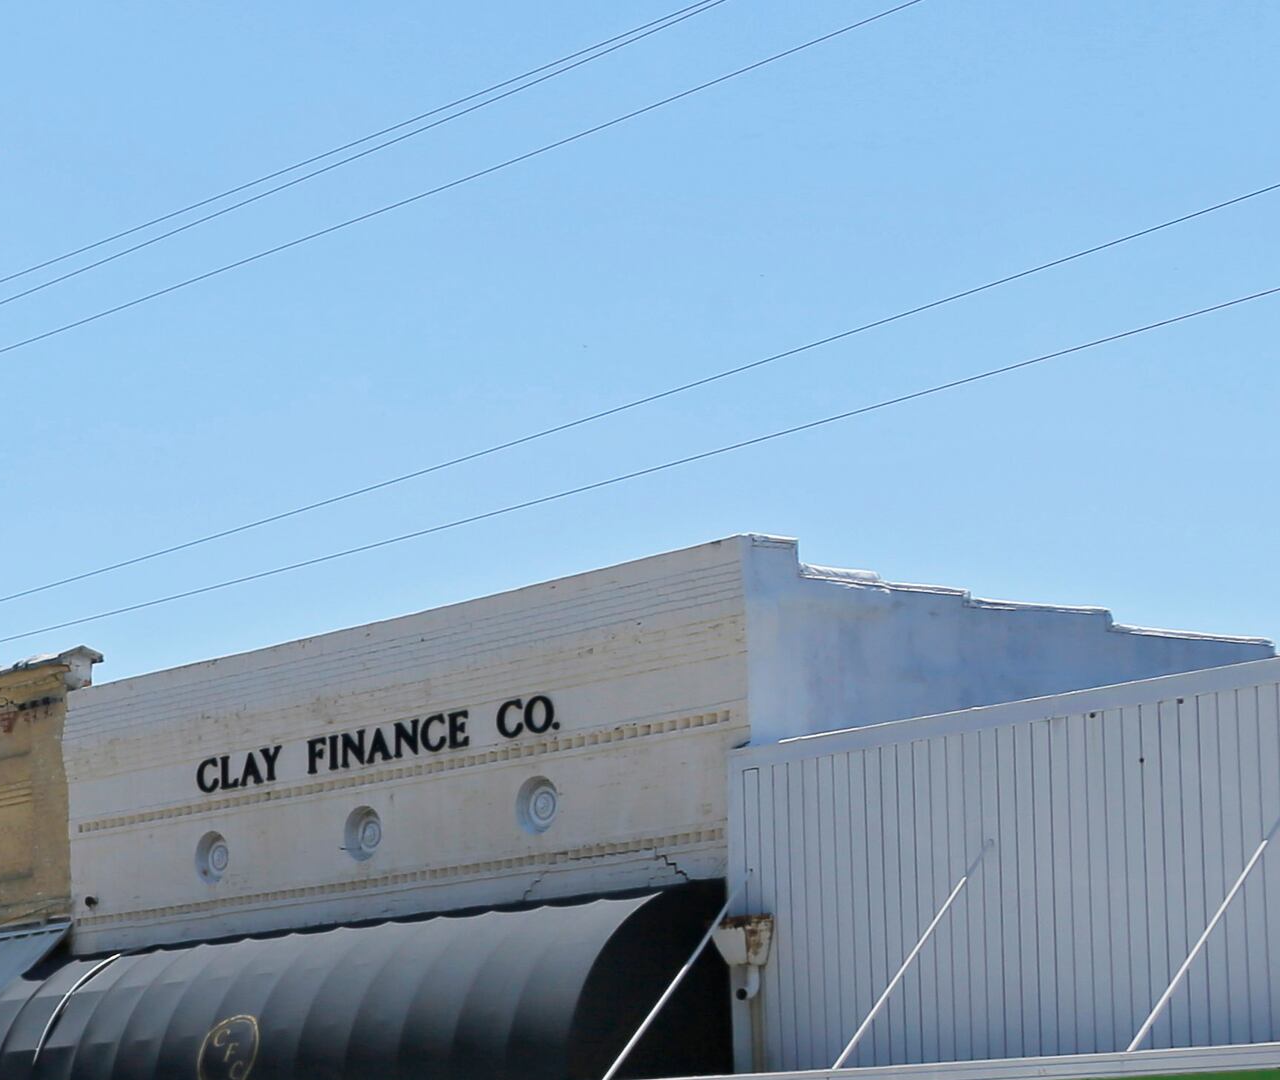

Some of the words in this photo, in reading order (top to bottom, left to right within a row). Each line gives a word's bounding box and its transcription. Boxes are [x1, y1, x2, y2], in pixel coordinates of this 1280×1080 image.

[196, 745, 282, 793] CLAY
[307, 710, 469, 775] FINANCE
[496, 695, 561, 739] CO.
